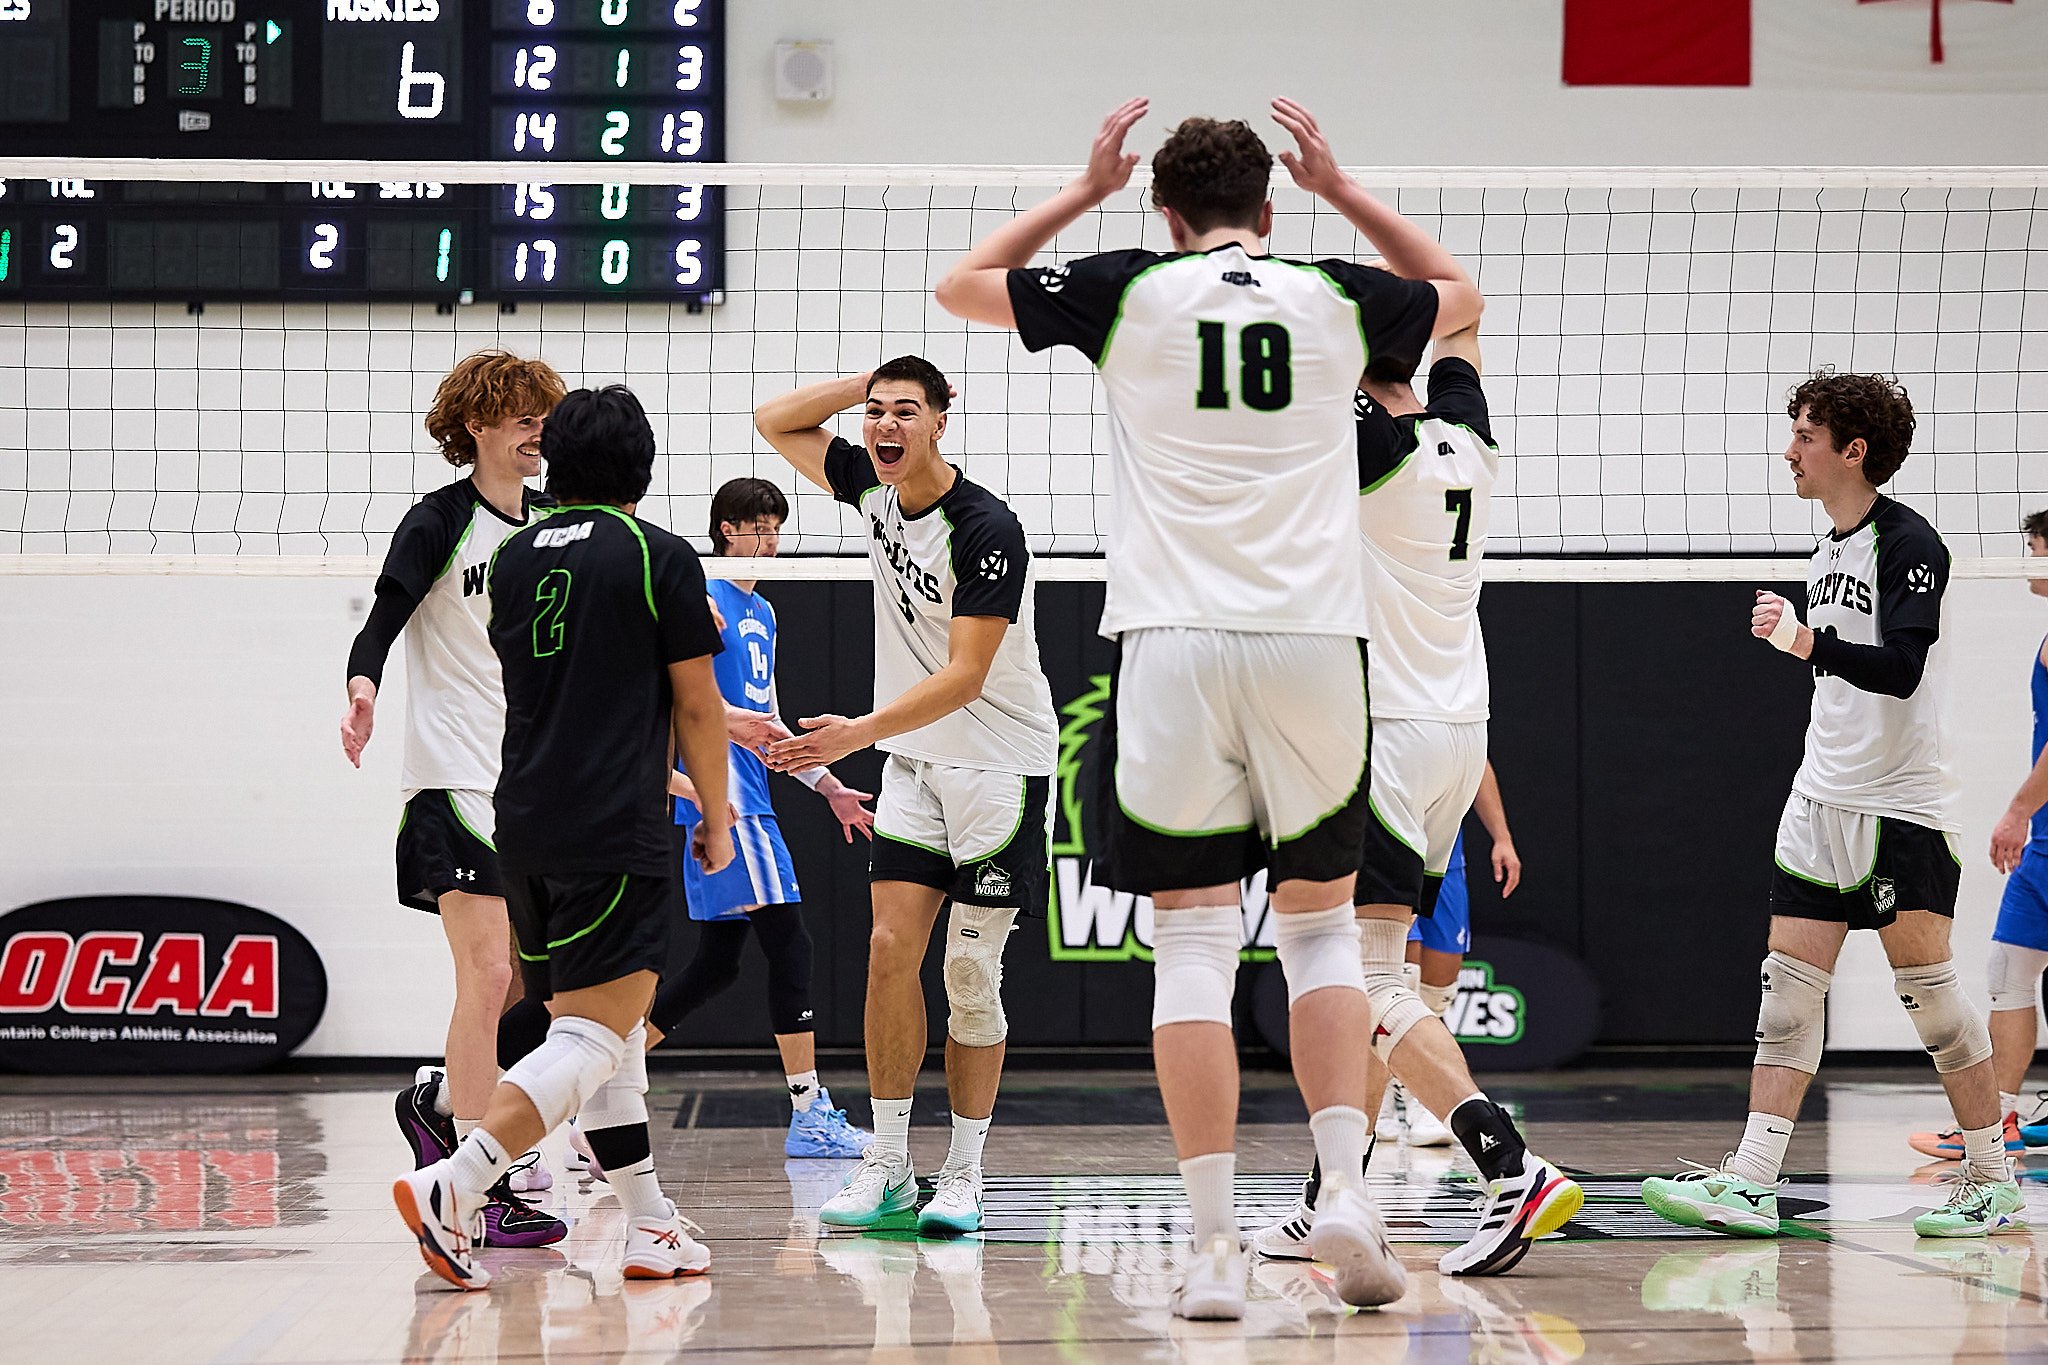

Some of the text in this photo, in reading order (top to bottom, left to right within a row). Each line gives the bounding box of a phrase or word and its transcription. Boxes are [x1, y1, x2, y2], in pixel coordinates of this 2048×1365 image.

[155, 0, 235, 21] PERIOD
[327, 0, 440, 21] HUSKIES
[134, 43, 154, 63] TO
[179, 38, 211, 93] 3
[236, 43, 256, 63] TO
[514, 45, 703, 90] 12 1 3
[398, 41, 445, 118] 6
[514, 111, 703, 155] 14 2 13
[514, 182, 703, 220] 15 0 3
[51, 224, 78, 268] 2
[310, 224, 339, 268] 2
[437, 229, 451, 281] 1
[515, 240, 701, 284] 17 0 5
[1195, 319, 1293, 412] 18
[532, 521, 595, 549] OCAA
[1444, 487, 1472, 561] 7
[533, 569, 572, 657] 2
[748, 641, 769, 680] 14
[975, 884, 1010, 896] WOLVES
[0, 931, 279, 1018] OCAA
[50, 1026, 117, 1043] Colleges
[120, 1026, 182, 1041] Athletic
[186, 1028, 278, 1044] Association
